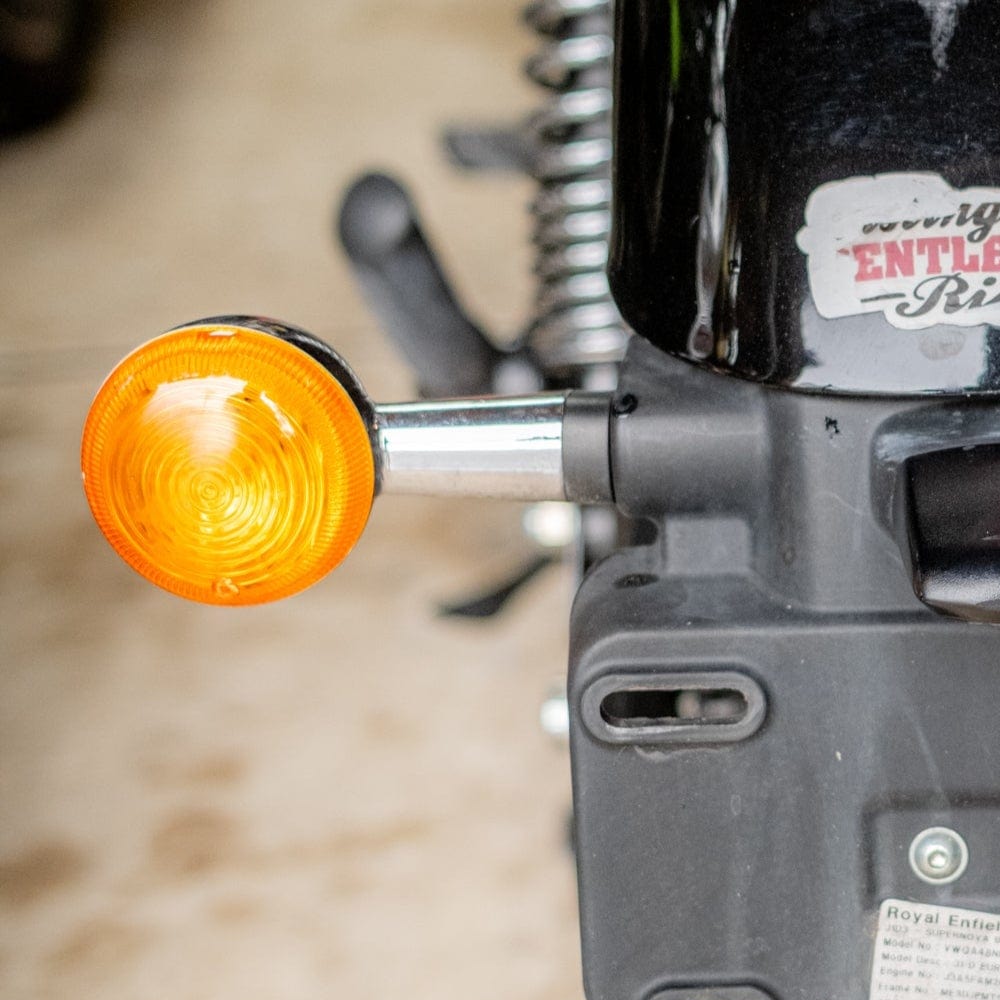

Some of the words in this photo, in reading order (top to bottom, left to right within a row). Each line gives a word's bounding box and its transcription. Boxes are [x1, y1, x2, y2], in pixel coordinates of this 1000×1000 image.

[886, 905, 939, 924] Royal
[883, 937, 913, 949] Model
[881, 952, 912, 963] Model
[880, 967, 913, 979] Engine
